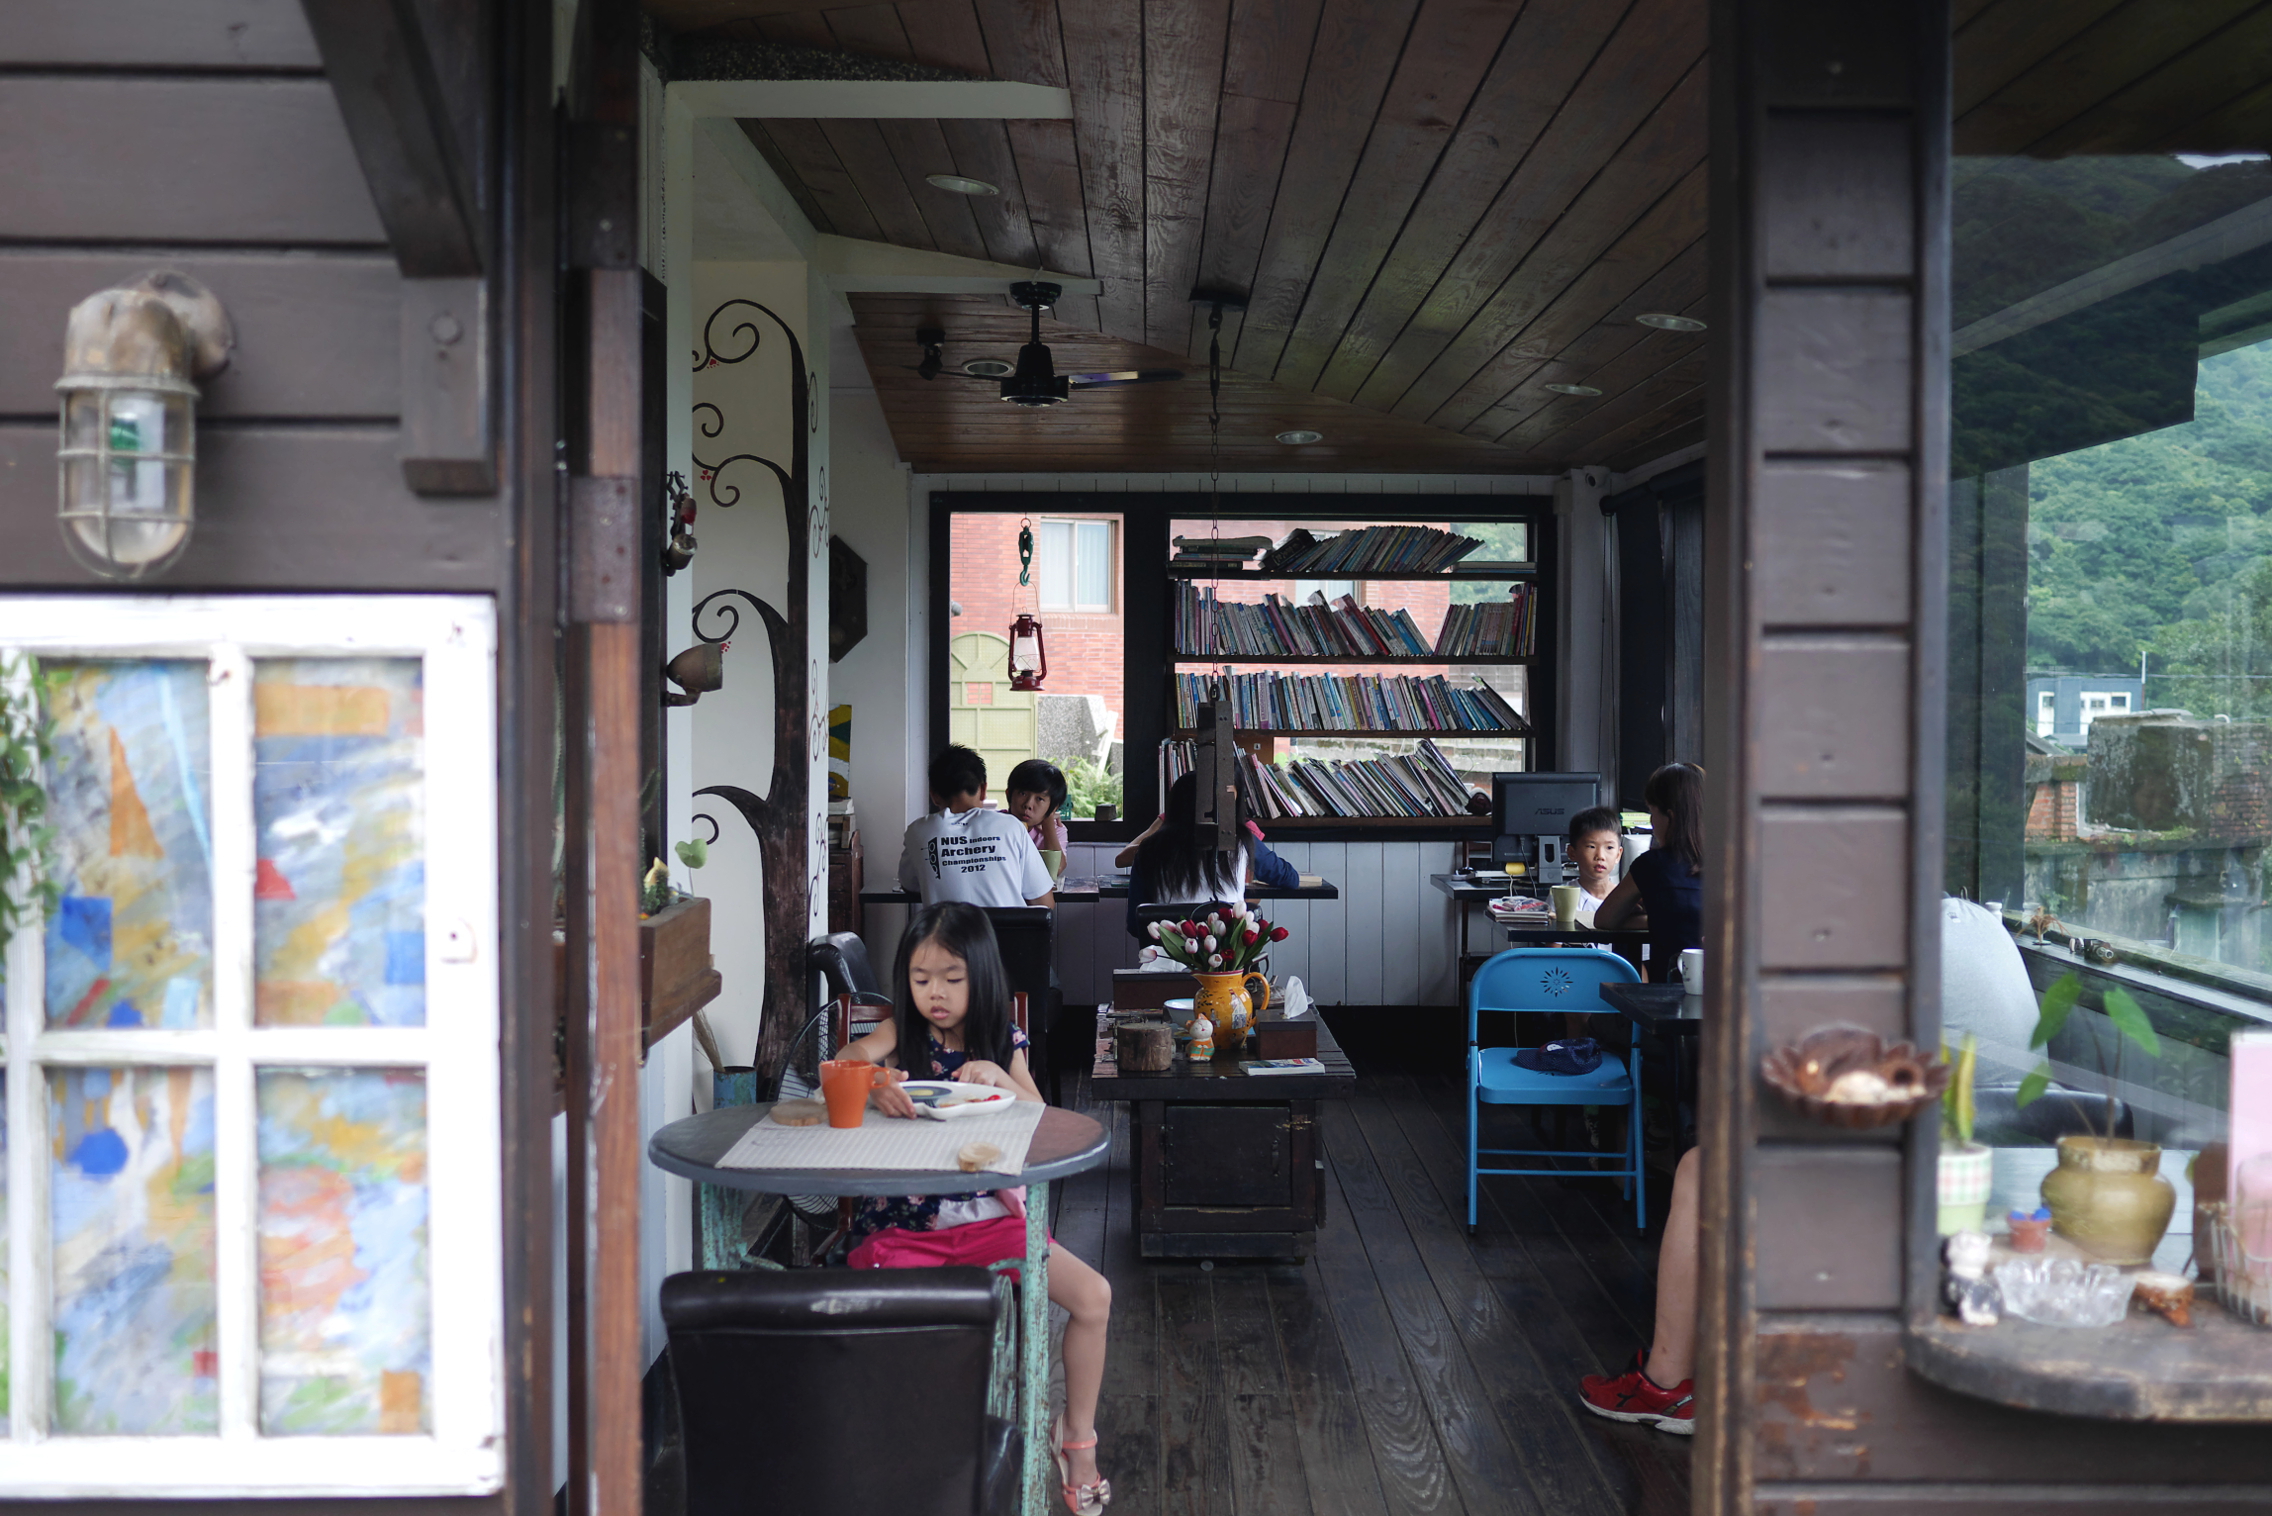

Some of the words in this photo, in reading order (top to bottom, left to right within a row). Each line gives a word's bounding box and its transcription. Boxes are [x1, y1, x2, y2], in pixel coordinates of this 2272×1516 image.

[941, 836, 968, 845] NUS
[941, 845, 996, 857] Archery
[942, 856, 1007, 866] Championships
[961, 864, 986, 873] 2012
